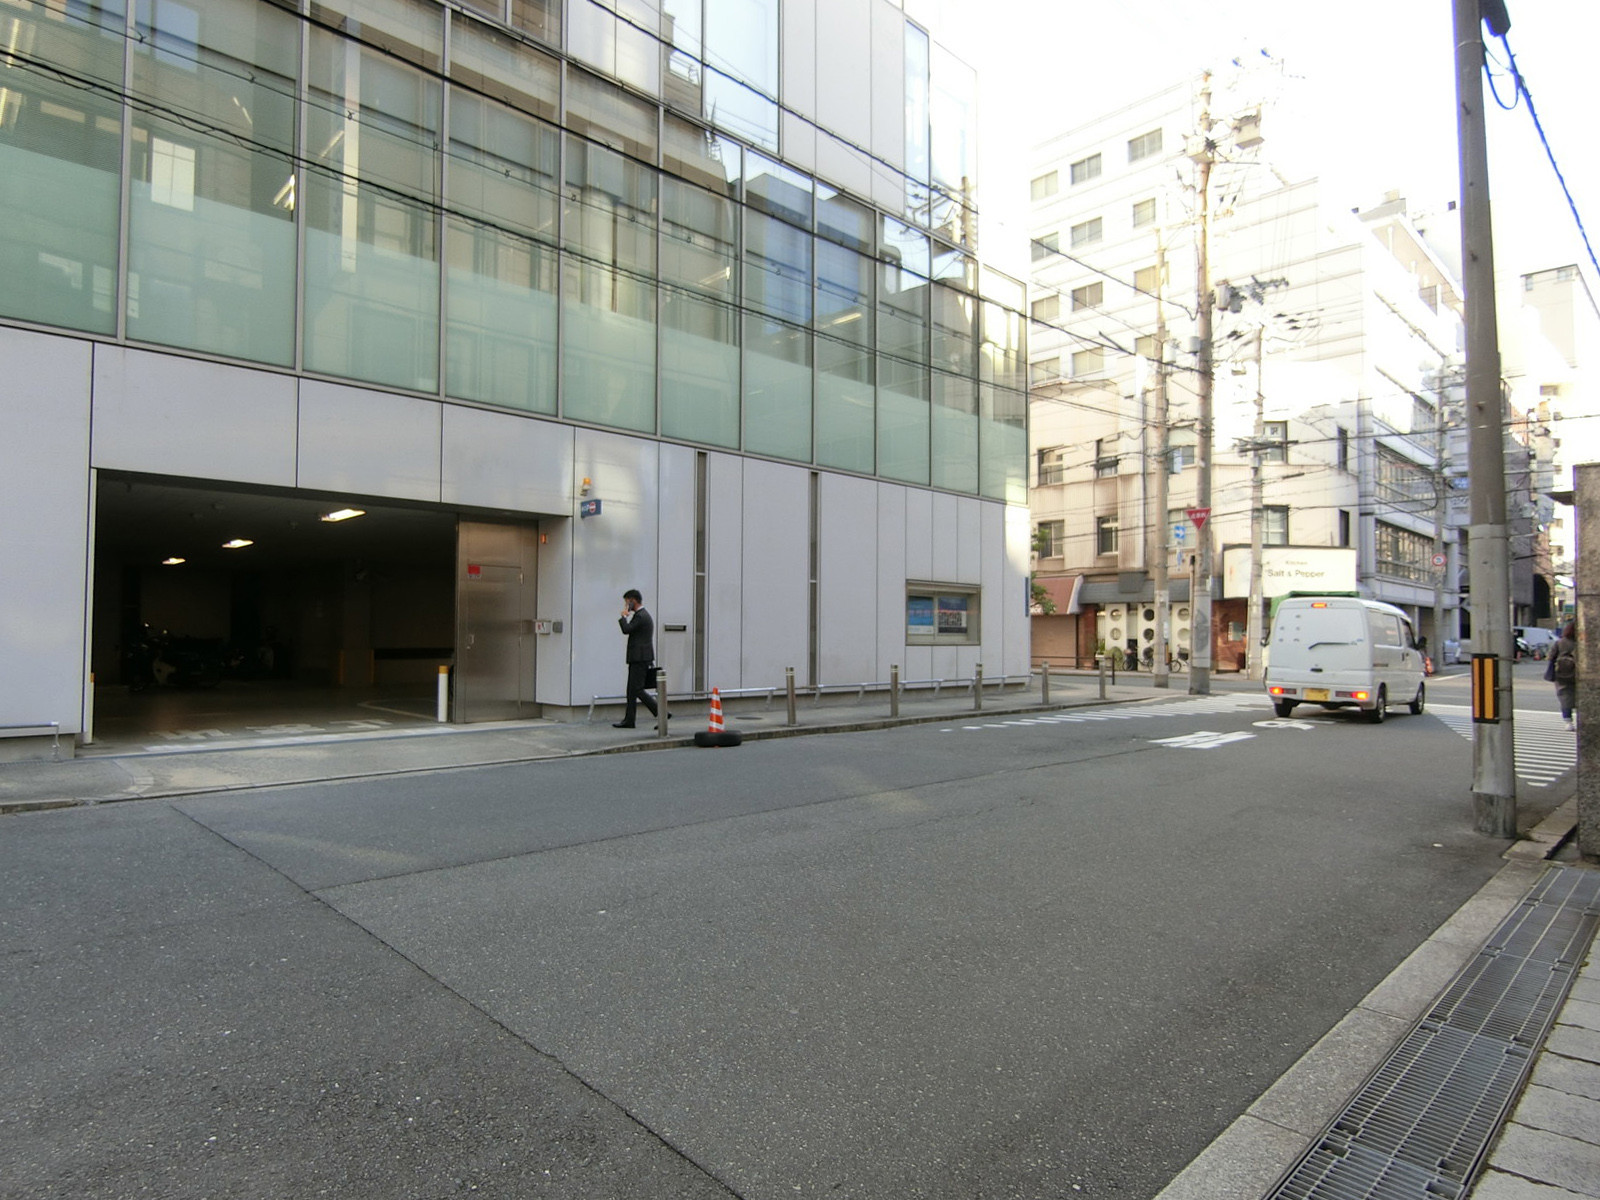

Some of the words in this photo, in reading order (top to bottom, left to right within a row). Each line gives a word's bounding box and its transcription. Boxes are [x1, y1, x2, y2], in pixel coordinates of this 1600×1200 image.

[1190, 511, 1207, 520] 止まれ
[1295, 568, 1325, 578] Pepper
